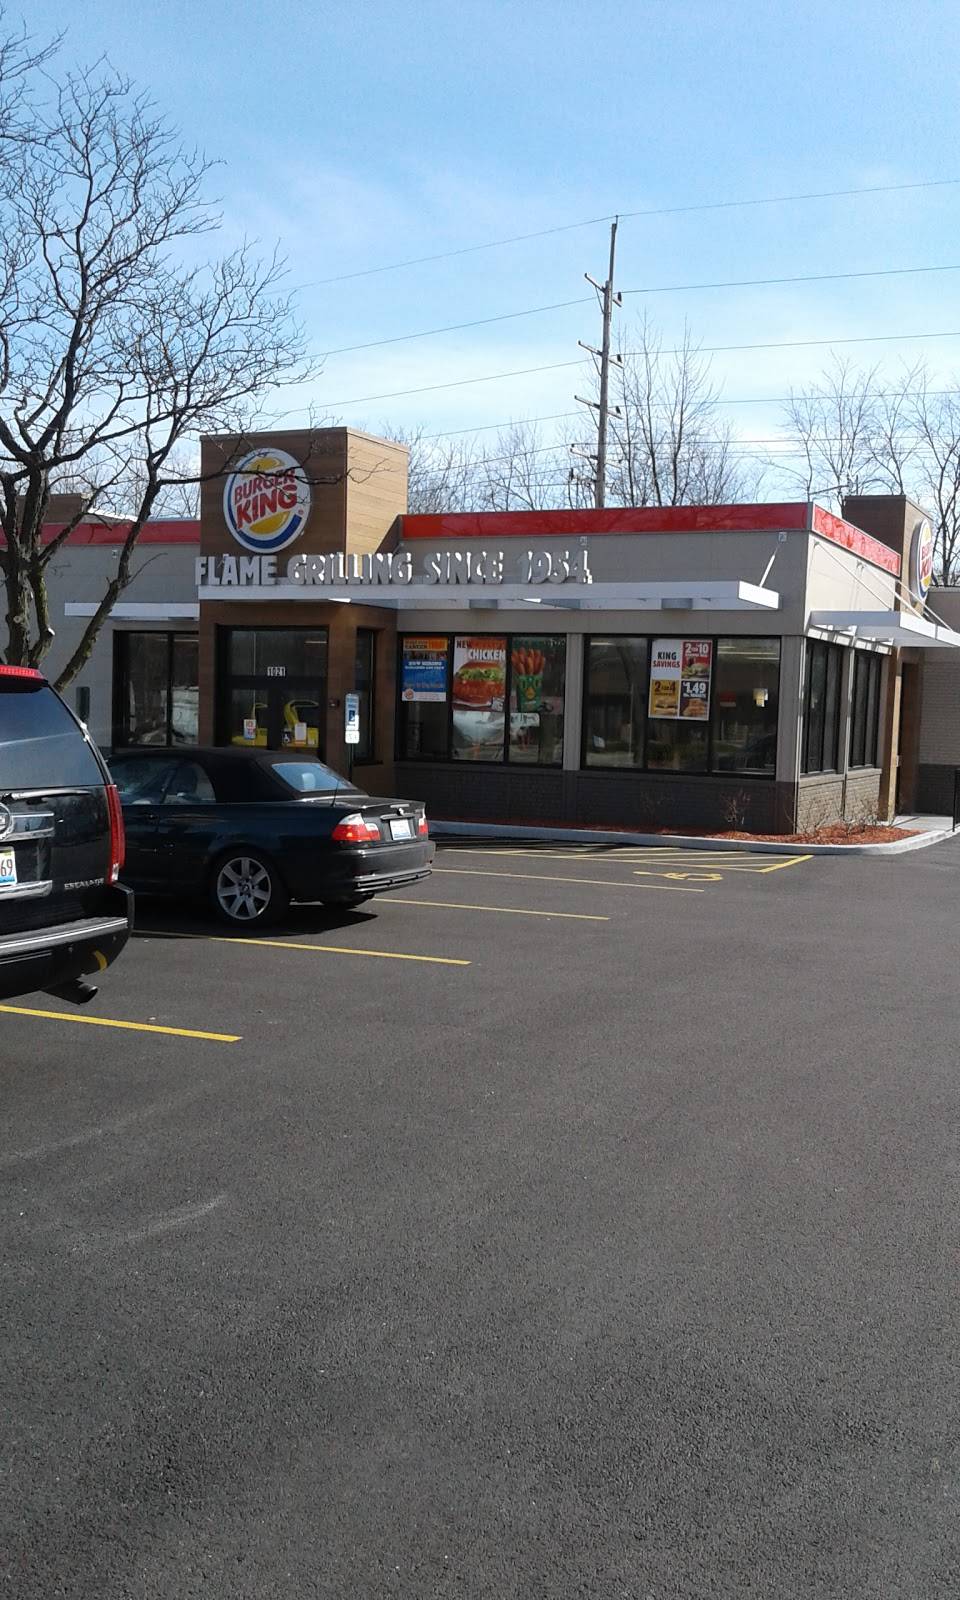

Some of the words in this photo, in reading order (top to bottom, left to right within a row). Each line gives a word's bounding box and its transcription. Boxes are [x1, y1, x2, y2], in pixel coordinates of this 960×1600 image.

[235, 468, 296, 505] BURGER
[236, 484, 298, 530] KING
[195, 554, 277, 586] FLAME
[286, 552, 413, 586] GRILLING
[424, 551, 504, 585] SINCE
[468, 649, 506, 660] CHICKEN
[653, 660, 680, 668] SAVINGS
[657, 652, 677, 660] KING
